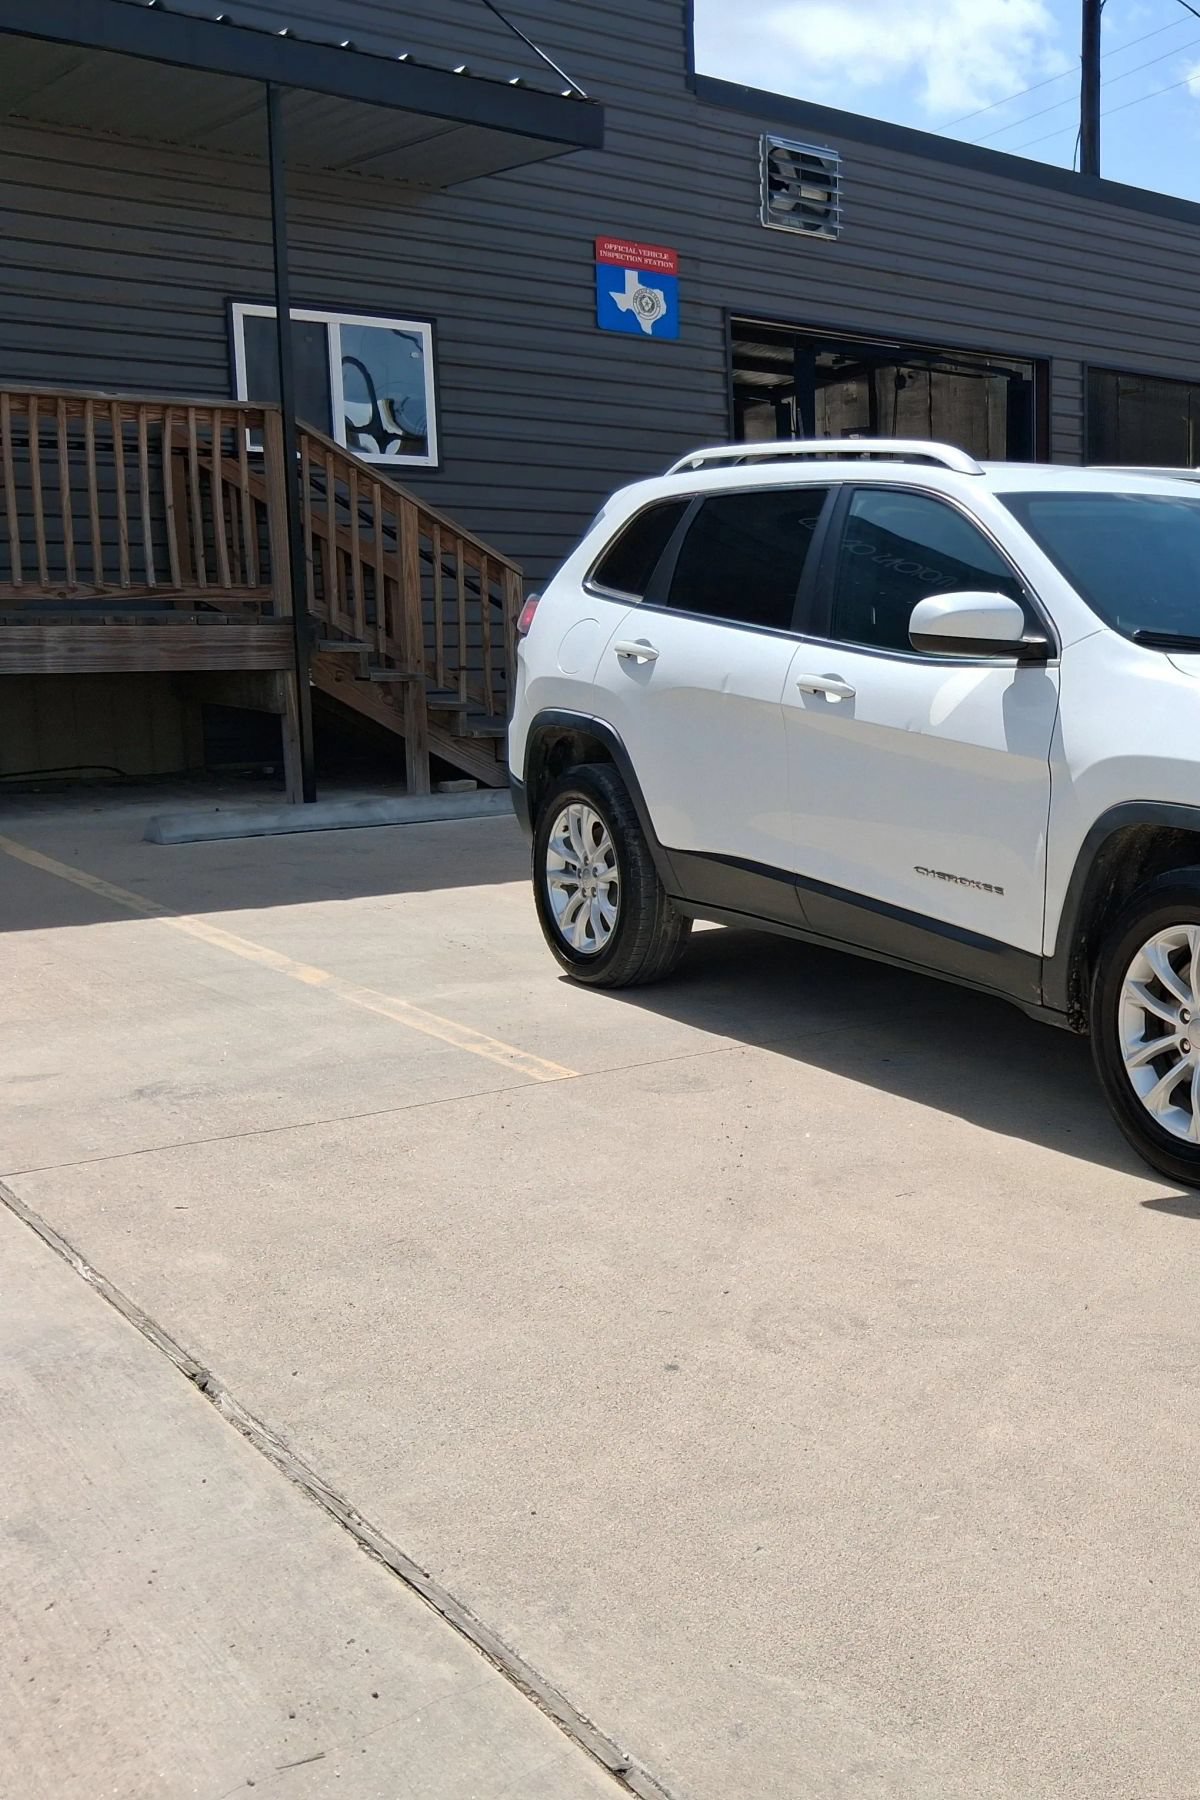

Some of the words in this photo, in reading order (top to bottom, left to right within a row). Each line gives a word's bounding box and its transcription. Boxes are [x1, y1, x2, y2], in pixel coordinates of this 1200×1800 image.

[600, 249, 642, 263] INSPECTION
[644, 257, 675, 269] STATION
[604, 243, 638, 255] OFFICIAL
[639, 248, 670, 260] VEHICLE
[913, 865, 1005, 896] CHEROKEE
